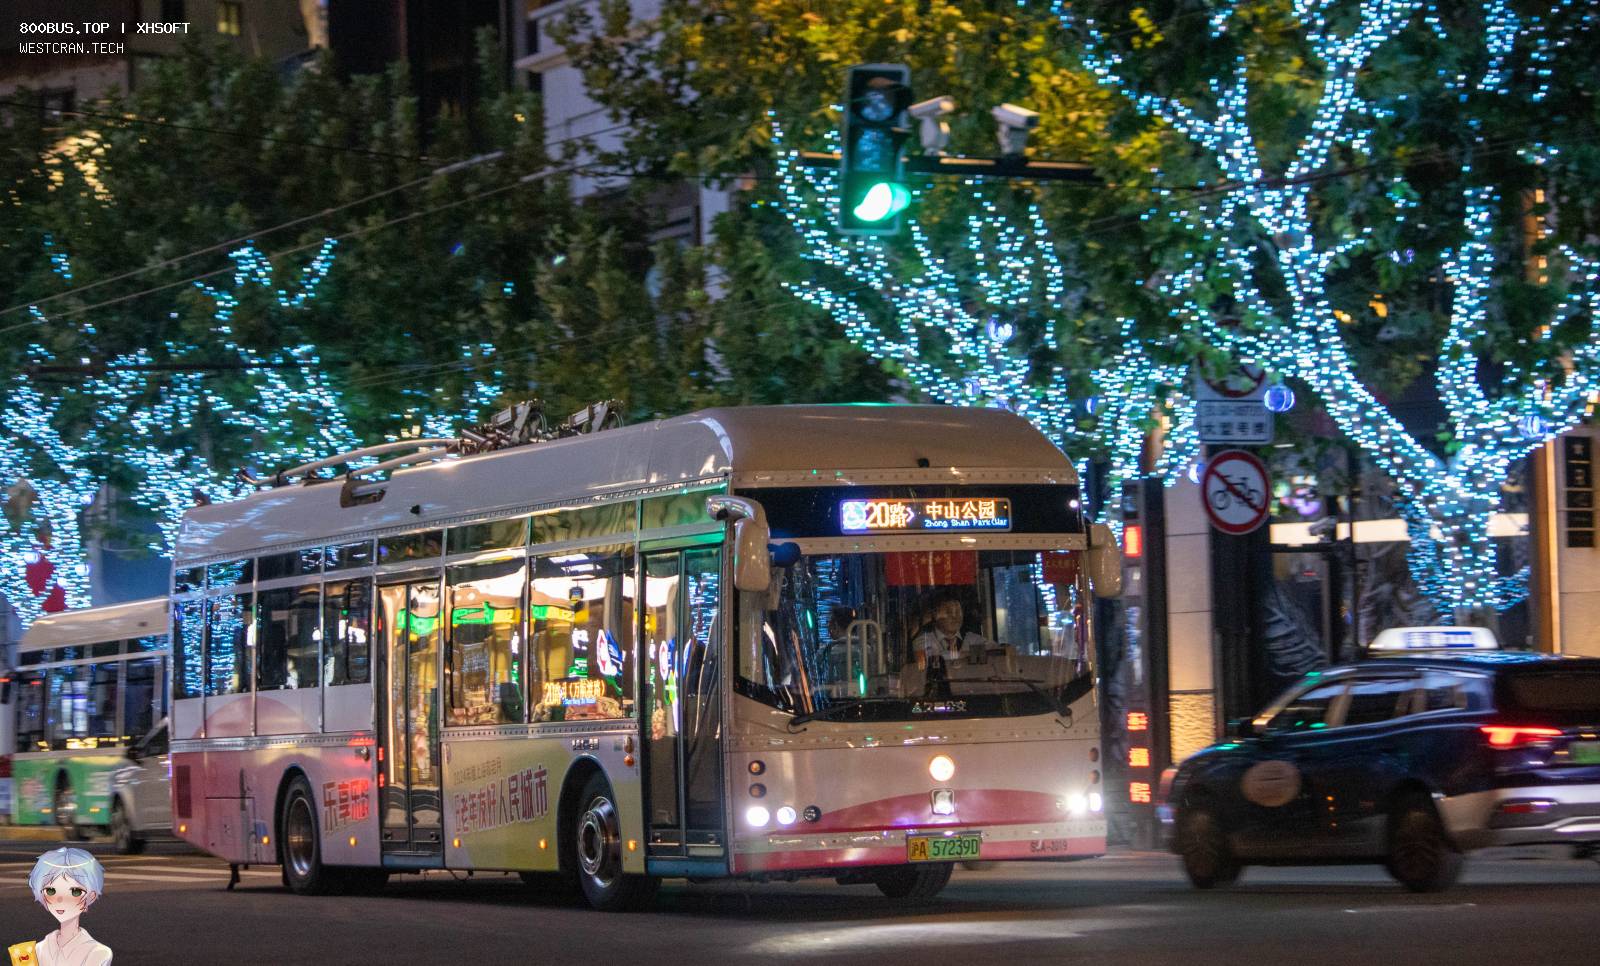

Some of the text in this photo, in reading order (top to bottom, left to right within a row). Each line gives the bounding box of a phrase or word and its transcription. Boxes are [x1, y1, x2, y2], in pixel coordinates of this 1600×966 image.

[925, 500, 995, 520] 中山公园
[924, 519, 948, 528] Zhong
[952, 518, 969, 527] Shan
[932, 838, 978, 857] 57239D
